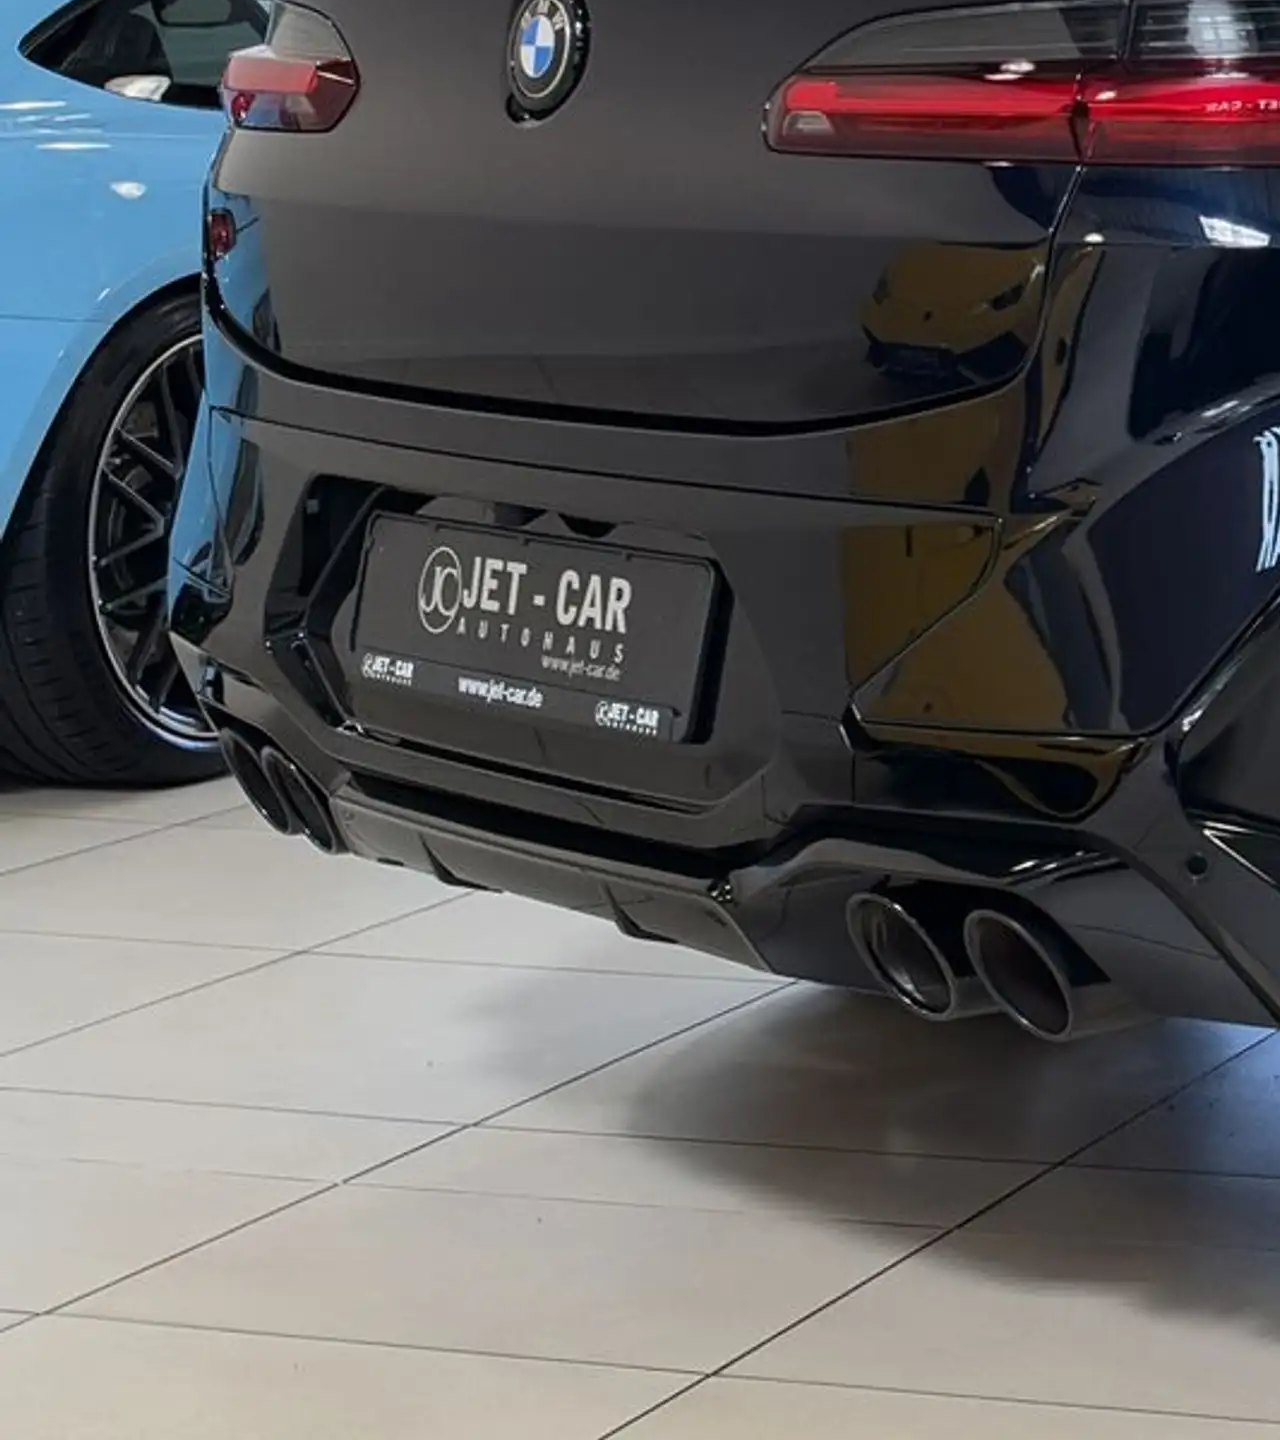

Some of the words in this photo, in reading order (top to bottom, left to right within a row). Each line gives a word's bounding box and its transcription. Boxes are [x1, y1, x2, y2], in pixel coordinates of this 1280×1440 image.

[463, 556, 528, 616] JET
[556, 568, 633, 635] CAR
[456, 616, 625, 664] AUTOHAUS
[541, 653, 621, 681] www.jet-car.de
[458, 675, 543, 708] www.jet-car.de
